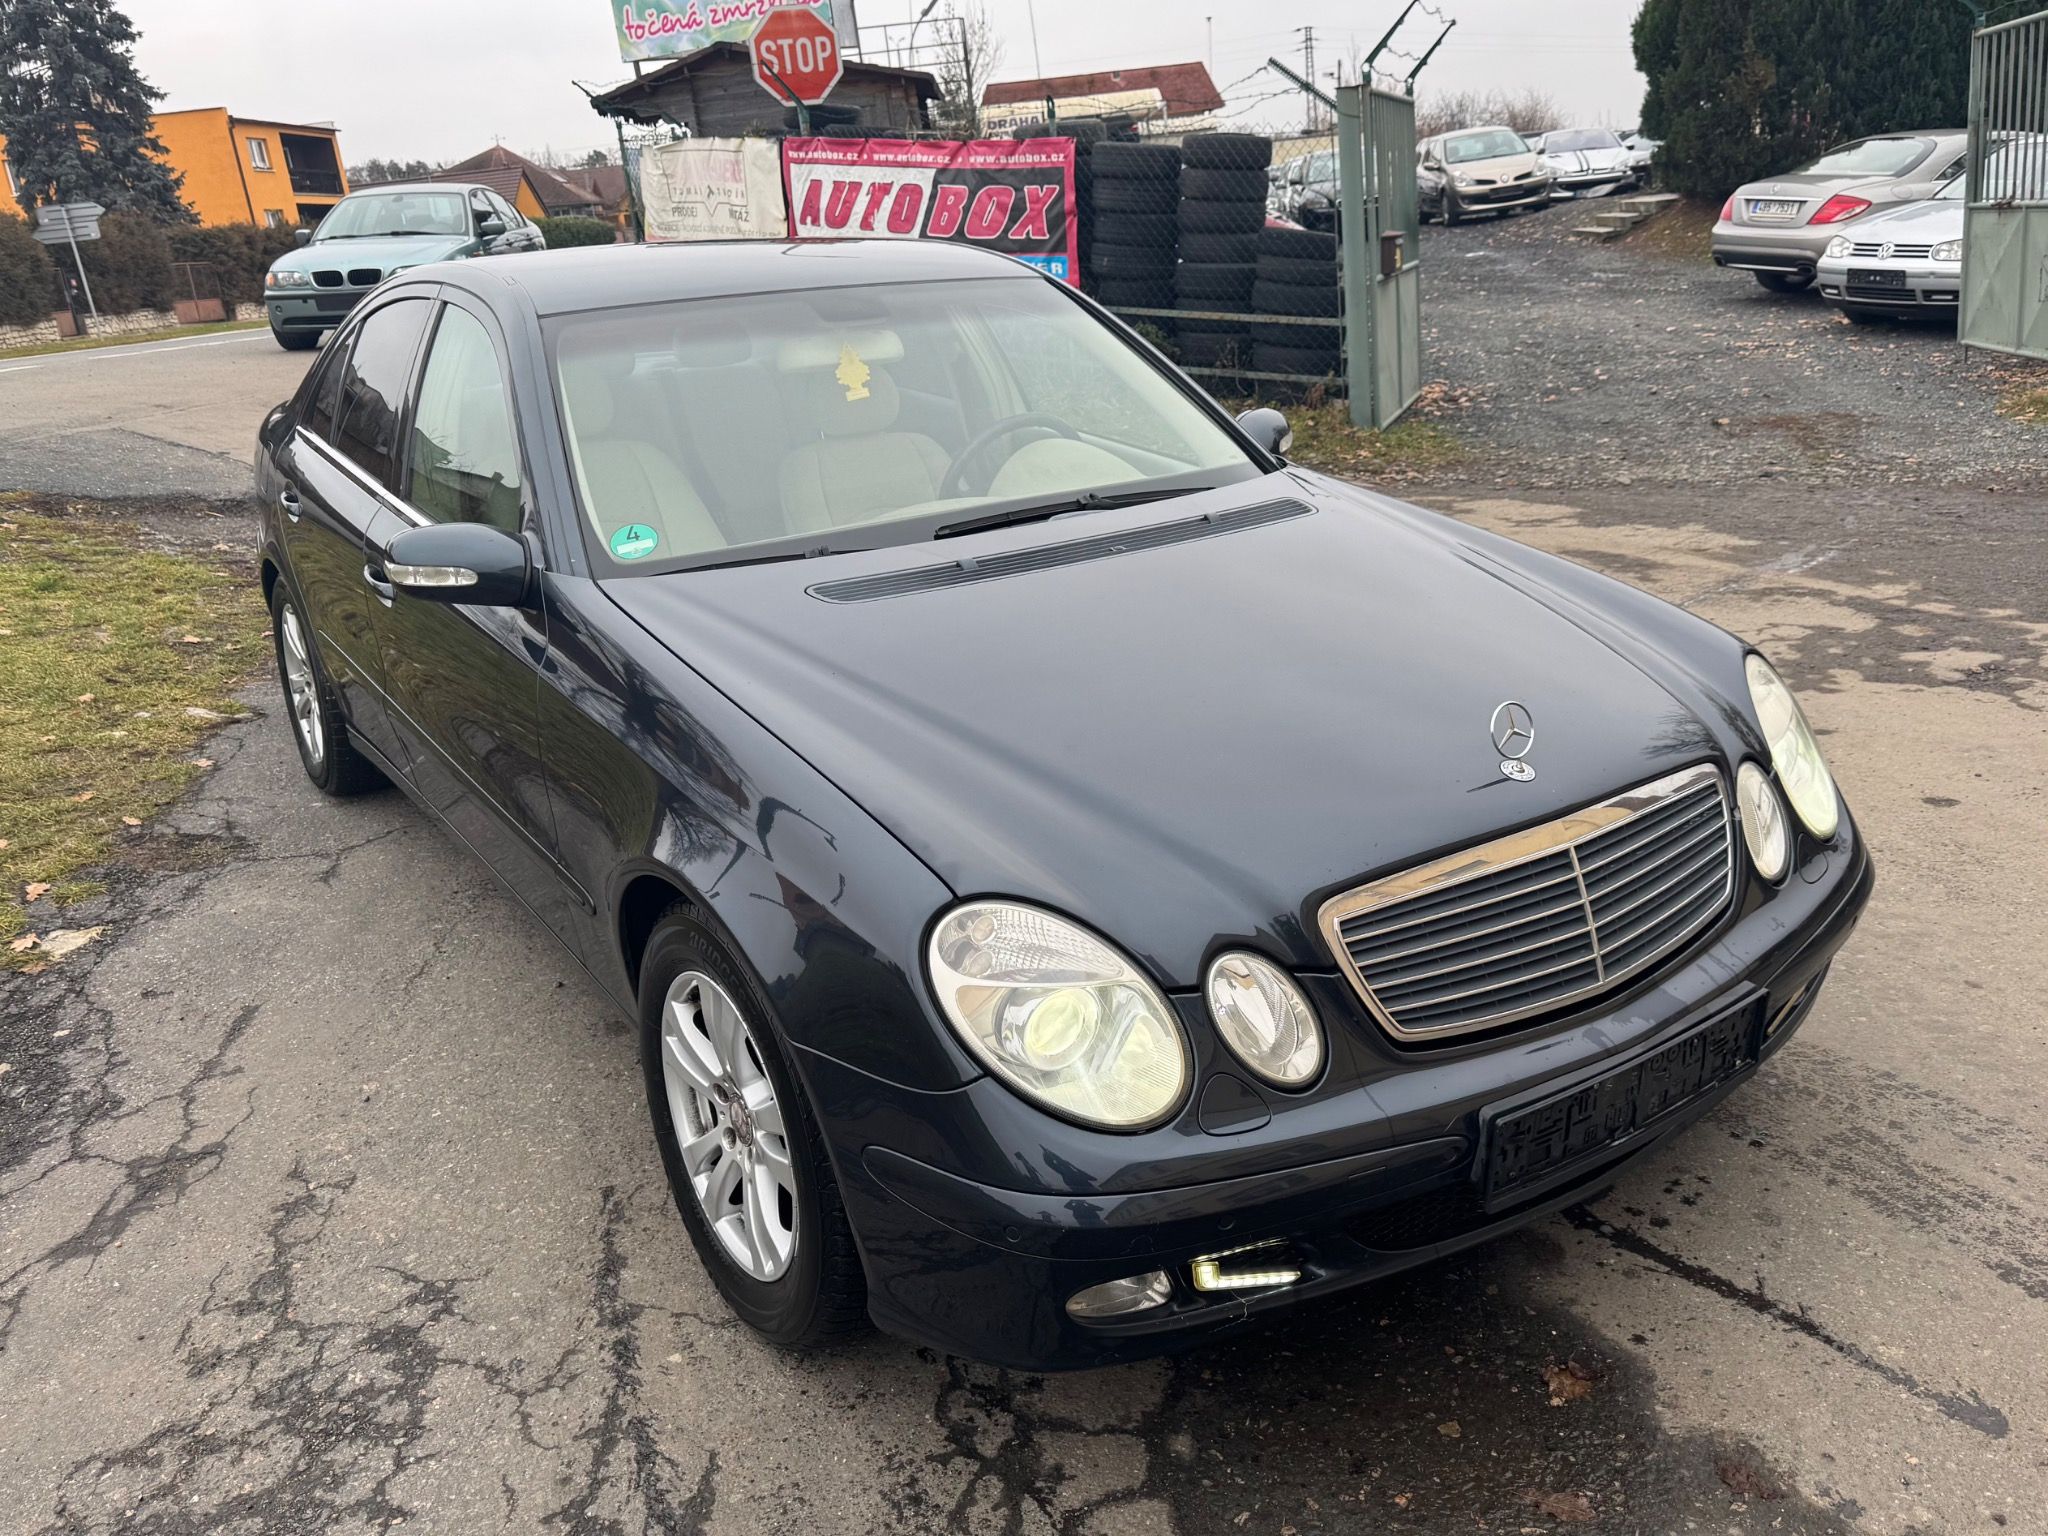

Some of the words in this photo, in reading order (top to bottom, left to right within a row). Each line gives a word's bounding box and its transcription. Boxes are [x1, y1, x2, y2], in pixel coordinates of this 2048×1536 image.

[624, 2, 703, 40] točená
[760, 36, 832, 76] STOP
[788, 150, 860, 161] www.autobox.cz
[873, 152, 951, 164] www.autobox.cz
[968, 152, 1066, 163] www.autobox.cz
[799, 178, 1060, 239] AUTOBOX
[626, 525, 641, 541] 4
